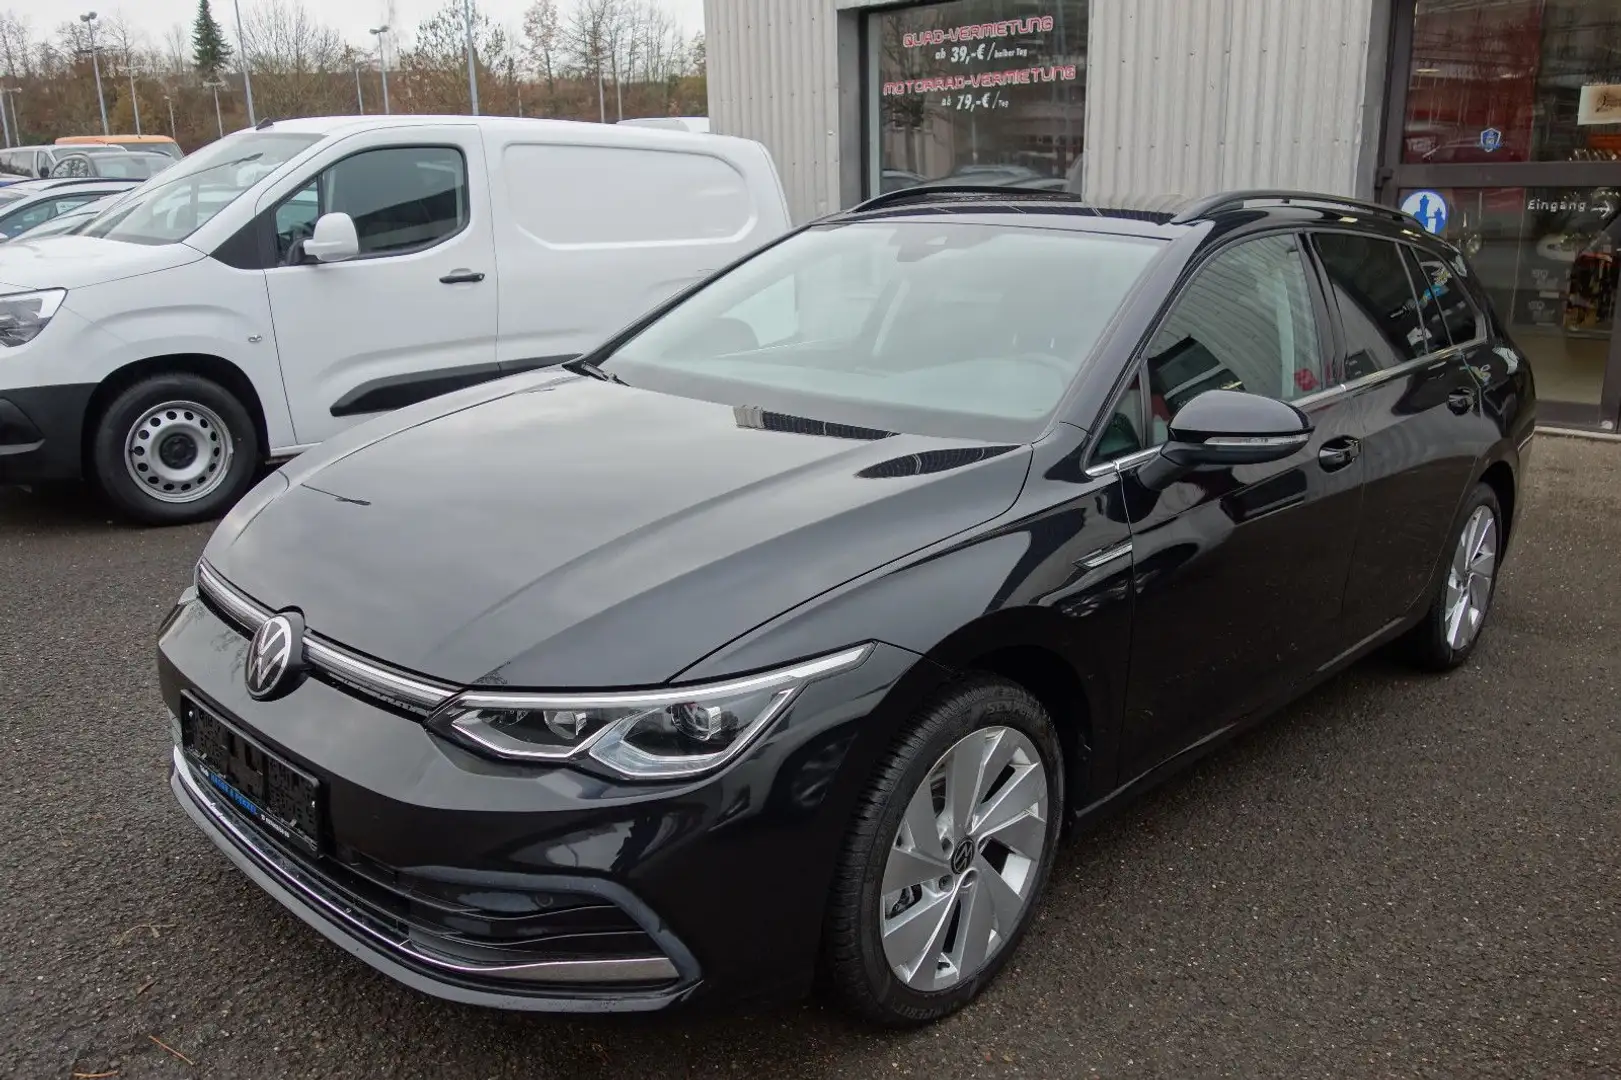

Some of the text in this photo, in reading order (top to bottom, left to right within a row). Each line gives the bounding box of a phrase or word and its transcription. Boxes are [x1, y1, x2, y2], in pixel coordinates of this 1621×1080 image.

[902, 16, 1054, 48] QUAD-VERMIETUNG
[935, 47, 946, 60] ab
[883, 65, 1076, 97] MOTORRAD-VERMIETUNG
[1527, 199, 1587, 212] Eingang
